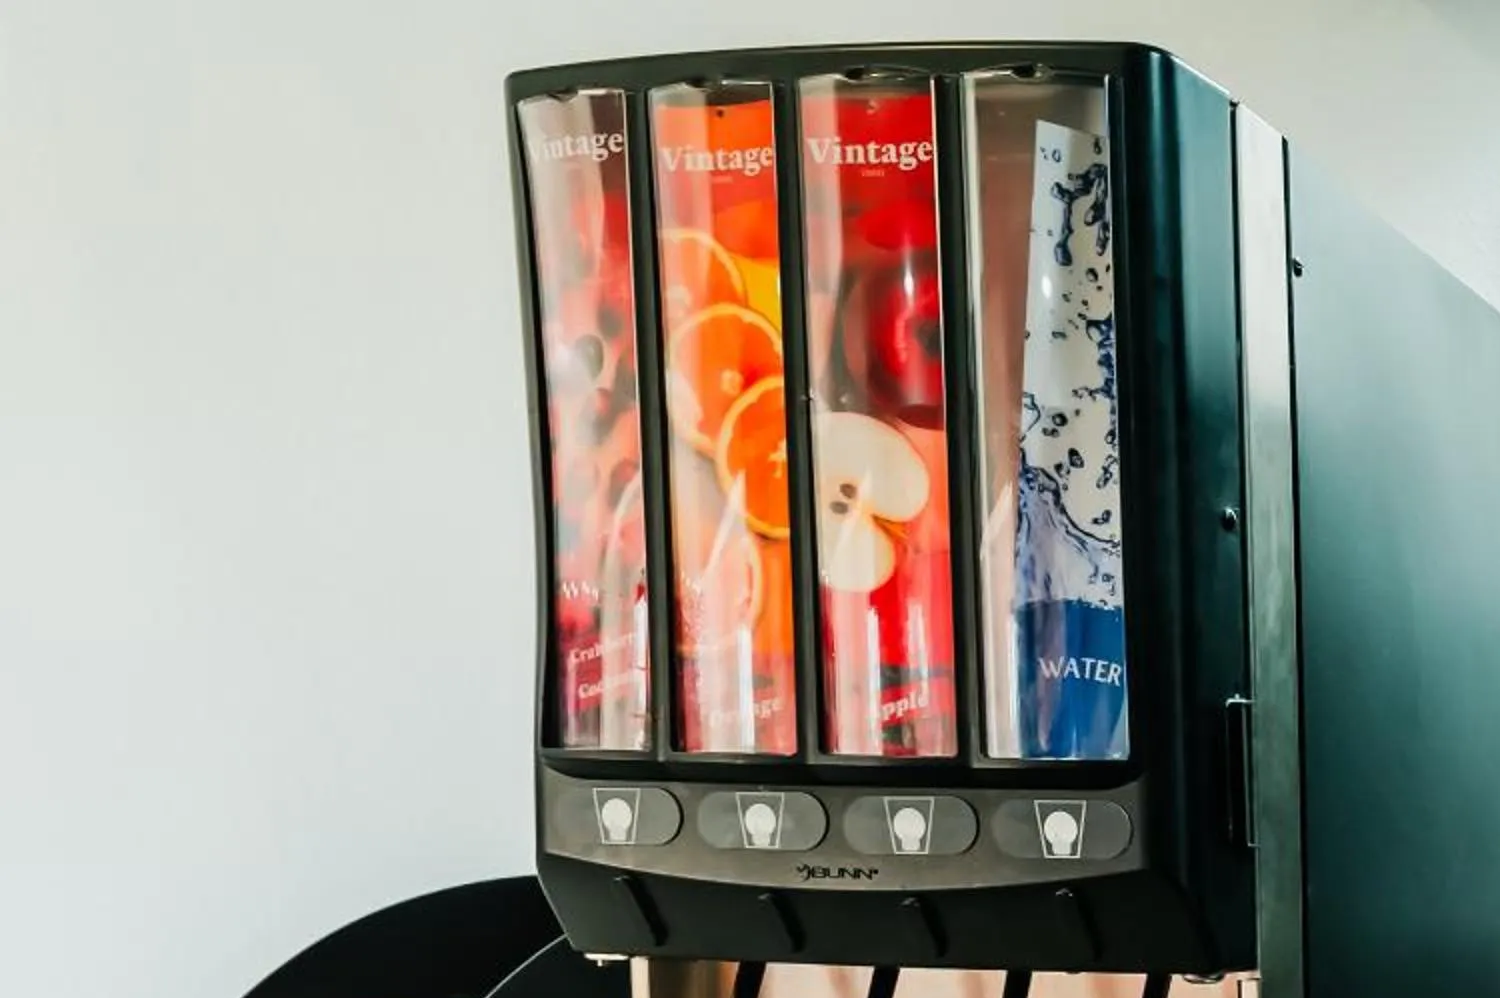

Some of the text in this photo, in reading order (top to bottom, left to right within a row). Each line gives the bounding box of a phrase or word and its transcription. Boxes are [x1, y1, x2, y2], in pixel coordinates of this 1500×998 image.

[528, 131, 625, 164] Vintage
[660, 144, 773, 177] Vintage
[806, 137, 933, 171] Vintage
[1037, 655, 1122, 687] WATER
